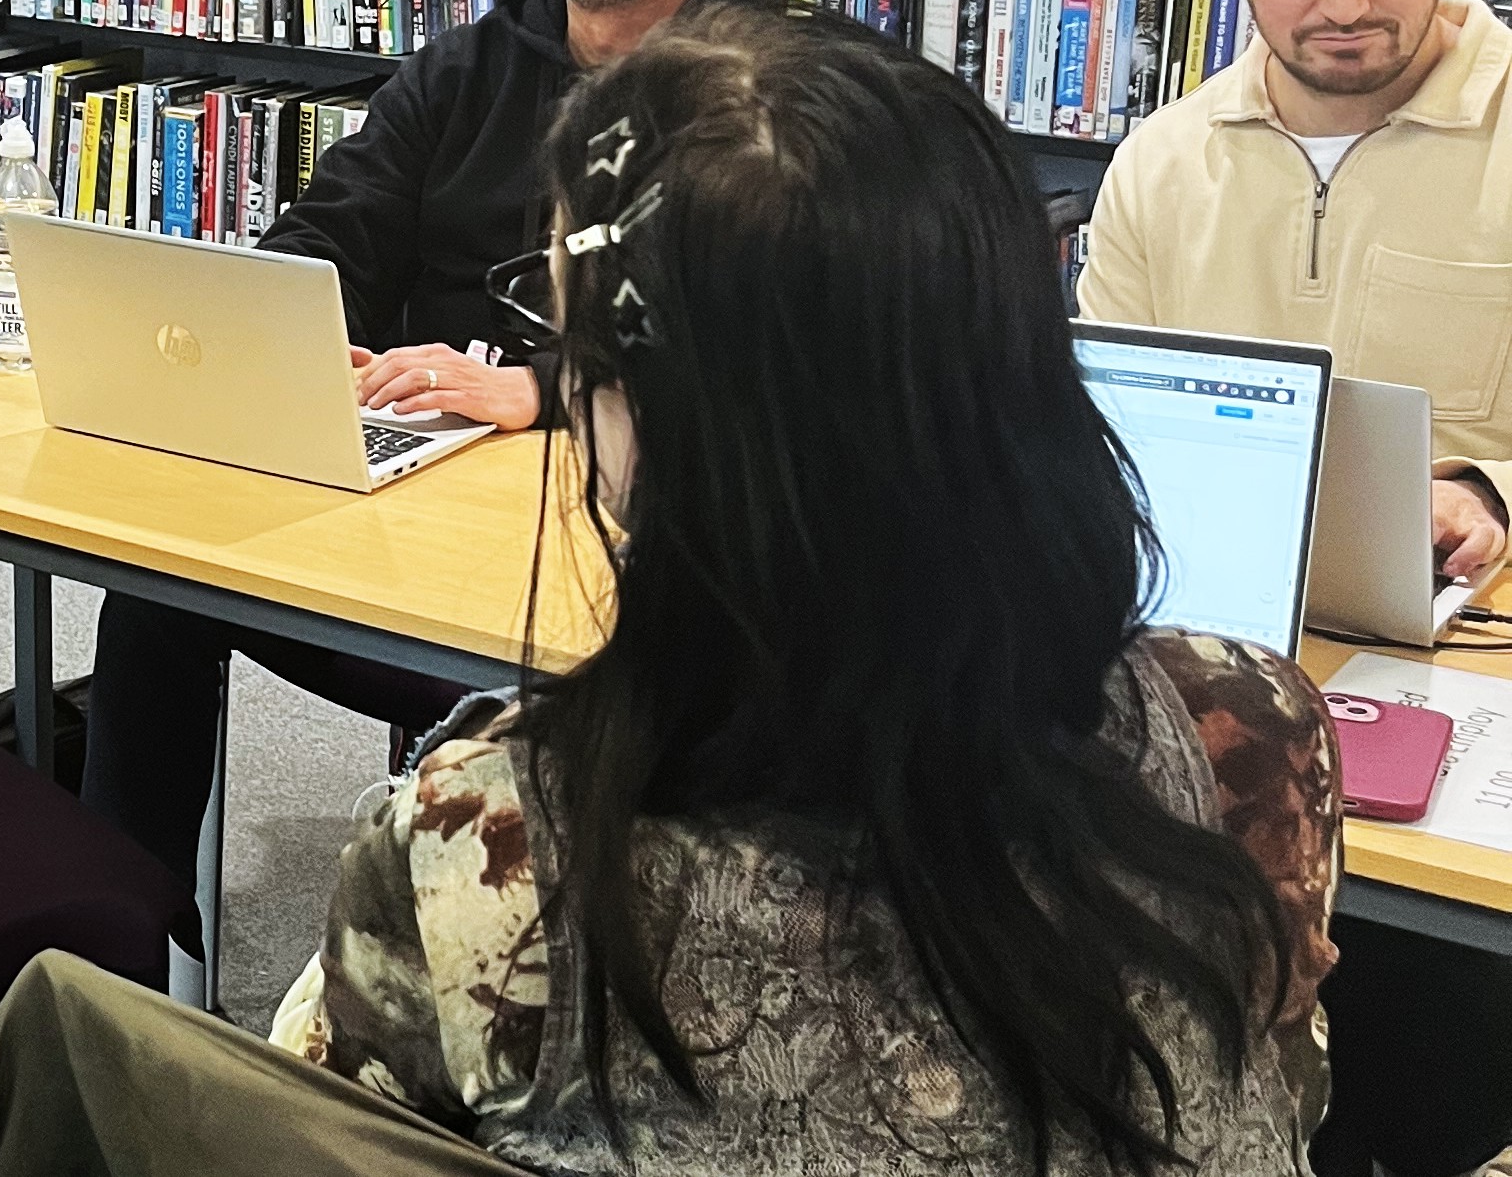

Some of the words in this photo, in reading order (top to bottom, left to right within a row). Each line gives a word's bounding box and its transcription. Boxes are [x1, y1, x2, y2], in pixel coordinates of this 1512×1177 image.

[1016, 18, 1025, 59] BETWEEN
[1078, 45, 1086, 61] THE
[1015, 61, 1023, 75] THE
[1076, 63, 1085, 83] MOST
[1013, 75, 1022, 101] WARS
[119, 92, 130, 122] MOBY
[176, 123, 186, 156] 1001
[227, 126, 237, 161] CYNDI
[299, 111, 312, 173] DEADLINE
[151, 159, 161, 196] oasis
[176, 160, 186, 210] SONGS
[226, 164, 236, 202] LAUPER
